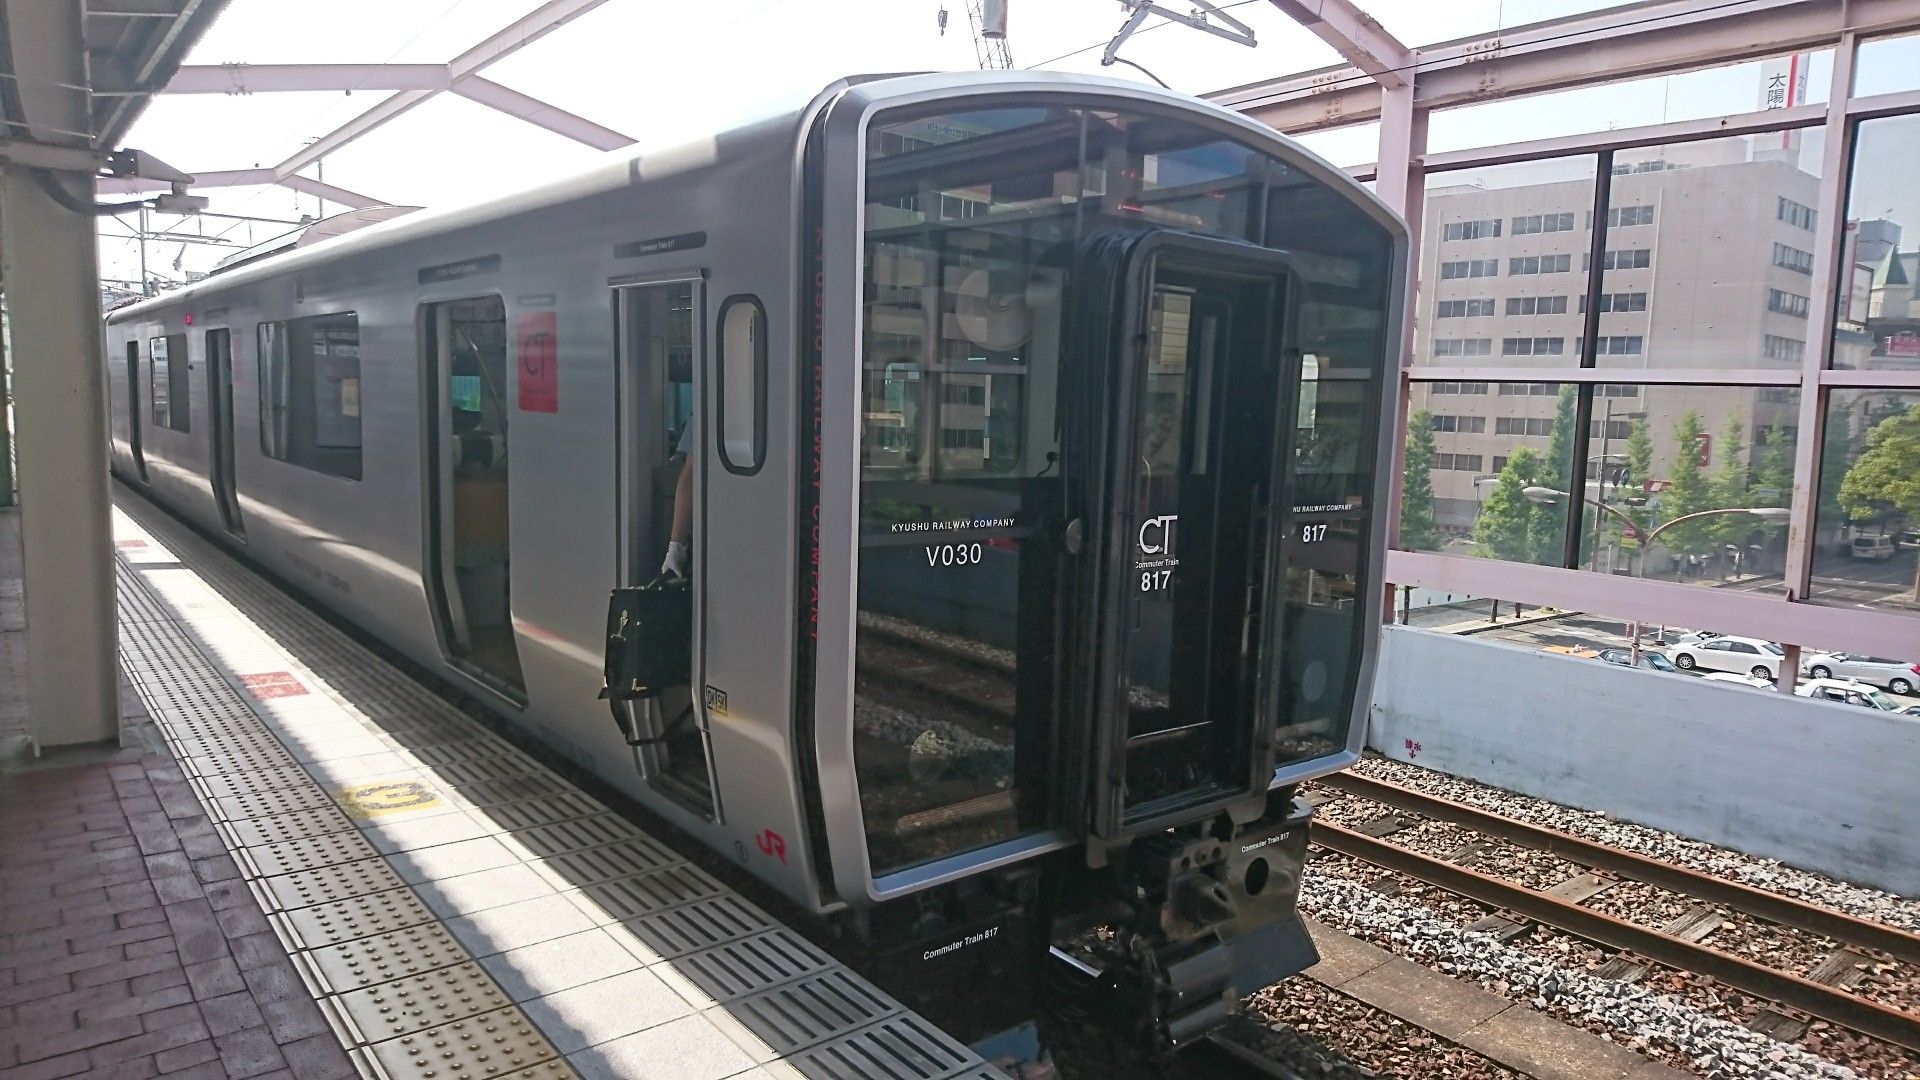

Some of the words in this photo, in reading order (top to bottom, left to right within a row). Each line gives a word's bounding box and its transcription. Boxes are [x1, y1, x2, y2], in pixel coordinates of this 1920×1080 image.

[1767, 73, 1787, 110] 太陽
[1301, 505, 1326, 513] RAILWAY
[891, 522, 930, 533] KYUSHU
[932, 520, 971, 531] RAILWAY
[973, 518, 1015, 528] COMPANY
[1139, 515, 1178, 554] CT
[1302, 524, 1327, 543] 817
[925, 543, 982, 567] V030
[1164, 558, 1180, 567] Train
[1141, 570, 1171, 592] 817
[755, 828, 789, 868] JR
[1241, 840, 1267, 853] Commuter
[1267, 835, 1280, 845] Train
[1280, 831, 1290, 841] 817
[923, 940, 963, 960] Commuter
[964, 933, 983, 946] Train
[984, 926, 999, 939] 817
